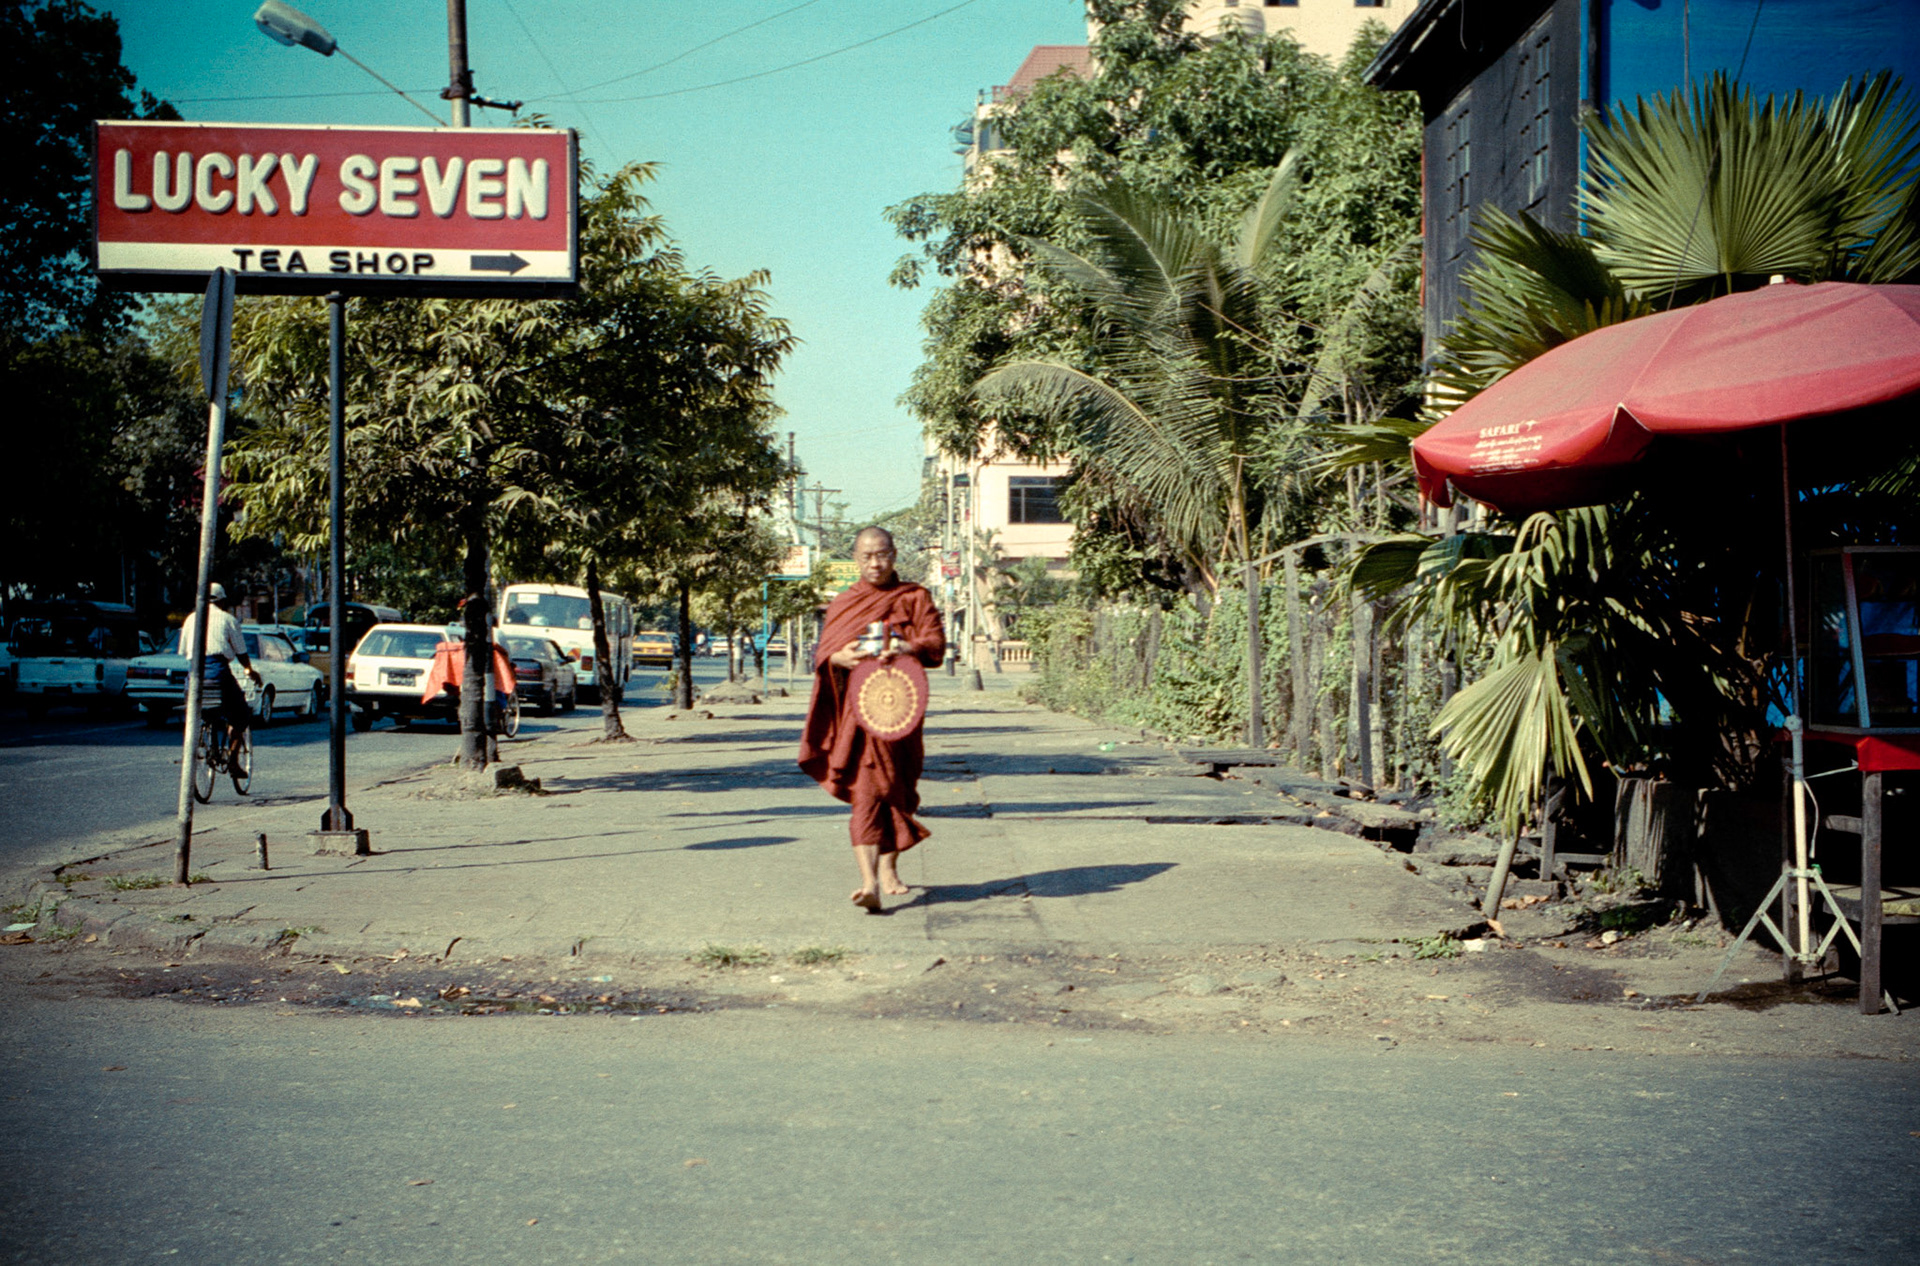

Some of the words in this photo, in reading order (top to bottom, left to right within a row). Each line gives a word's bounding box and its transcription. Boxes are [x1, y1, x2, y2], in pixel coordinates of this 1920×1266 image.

[115, 149, 318, 216] LUCKY
[339, 154, 549, 220] SEVEN
[233, 249, 307, 273] TEA
[329, 251, 436, 275] SHOP
[1479, 423, 1521, 439] SAFARI
